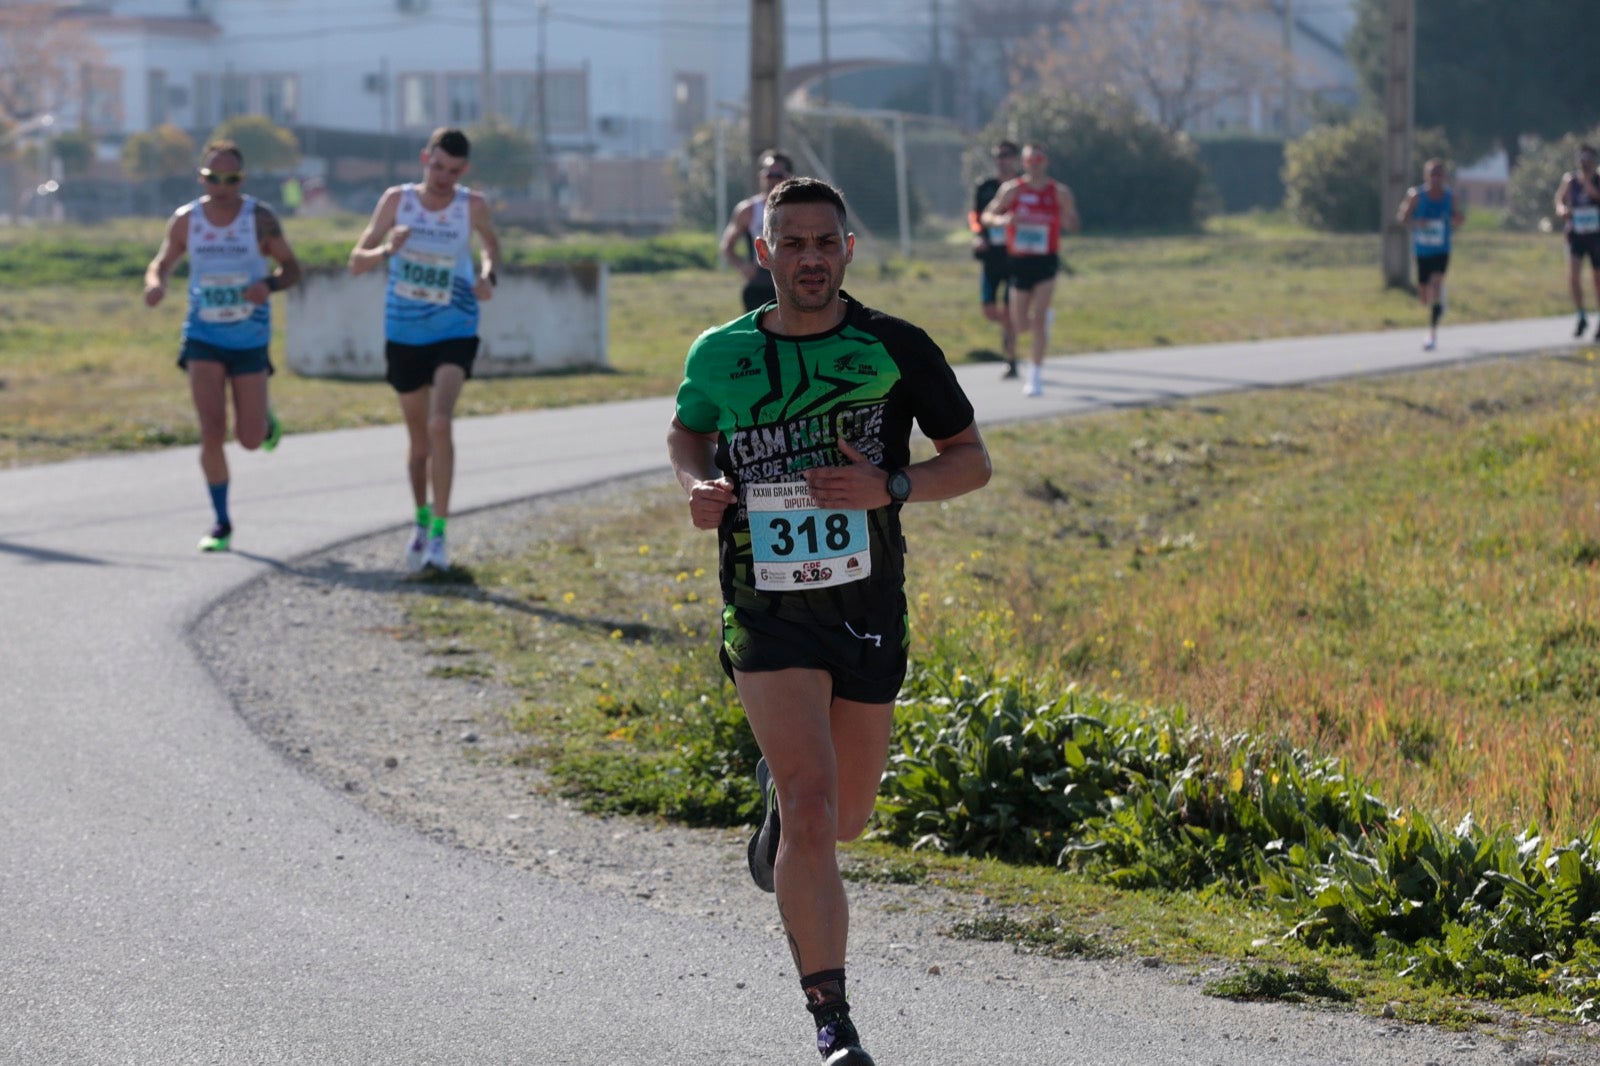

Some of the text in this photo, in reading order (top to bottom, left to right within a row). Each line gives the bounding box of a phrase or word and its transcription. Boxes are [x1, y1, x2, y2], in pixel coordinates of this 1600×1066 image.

[403, 262, 450, 288] 1088
[204, 286, 244, 306] 103
[752, 488, 772, 498] XXXIII
[773, 486, 793, 498] GRAN
[794, 485, 809, 497] PRE
[784, 497, 817, 509] DIPUTAC
[769, 513, 851, 557] 318
